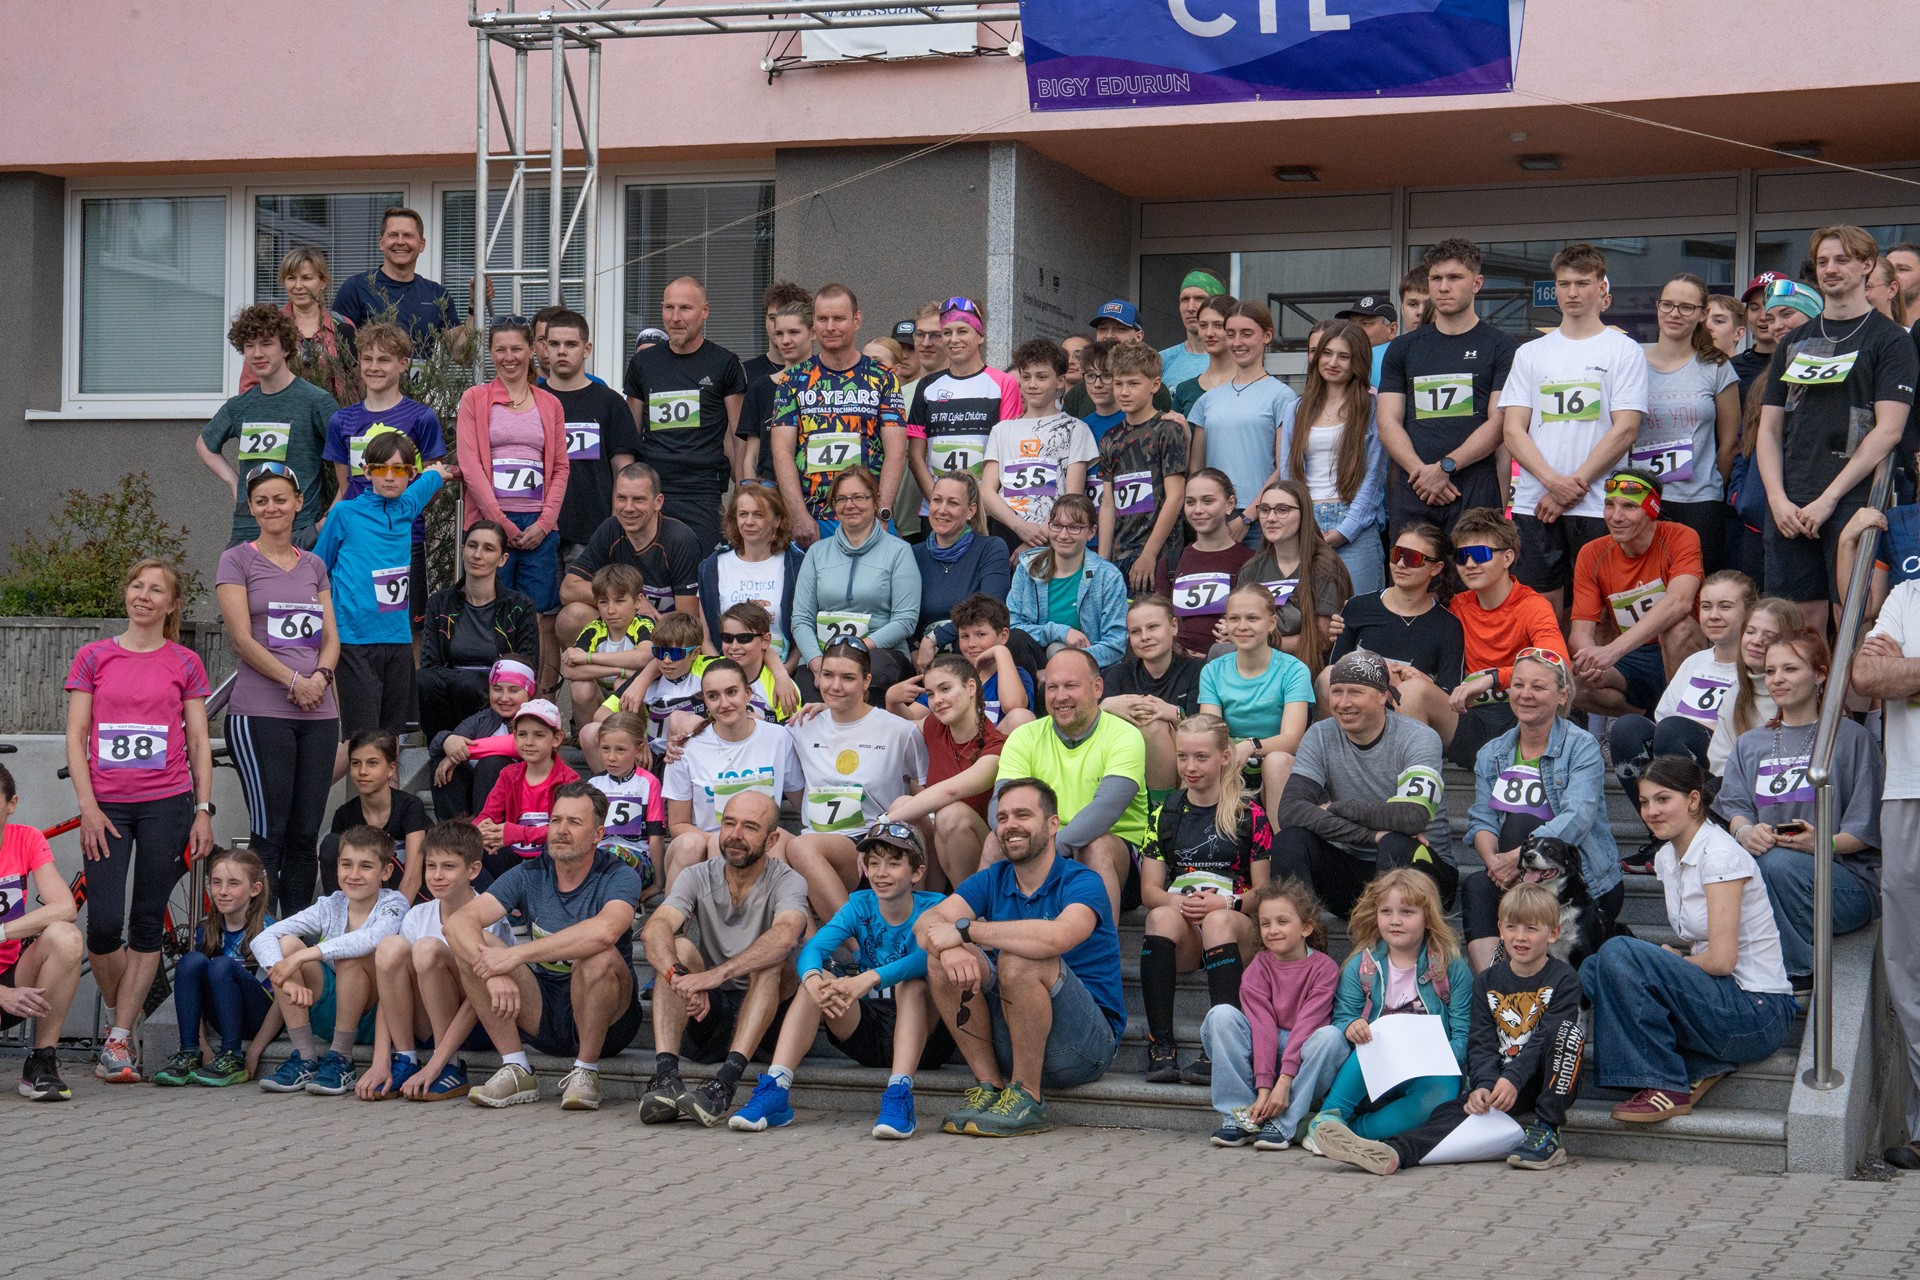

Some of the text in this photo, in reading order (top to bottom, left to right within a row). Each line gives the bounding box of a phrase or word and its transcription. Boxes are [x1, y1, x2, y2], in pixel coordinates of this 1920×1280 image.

[1037, 73, 1191, 98] BIGY EDURUN
[1798, 364, 1840, 380] 56
[799, 389, 880, 406] 10 YEARS
[1428, 387, 1457, 411] 17
[1554, 391, 1584, 414] 16
[658, 401, 690, 424] 30
[1669, 407, 1698, 428] YOU
[247, 433, 277, 453] 29
[818, 444, 850, 465] 47
[943, 451, 969, 471] 41
[1649, 452, 1676, 476] 51
[505, 469, 536, 491] 74
[1013, 468, 1046, 488] 55
[1118, 484, 1141, 507] 97
[386, 578, 409, 602] 92
[1185, 584, 1218, 608] 57
[281, 615, 313, 638] 66
[111, 735, 153, 760] 88
[1406, 777, 1437, 804] 51
[1504, 777, 1544, 808] 80
[1769, 768, 1807, 794] 67
[612, 802, 630, 826] 5
[826, 801, 842, 825] 7
[1555, 1052, 1577, 1094] ROUGH
